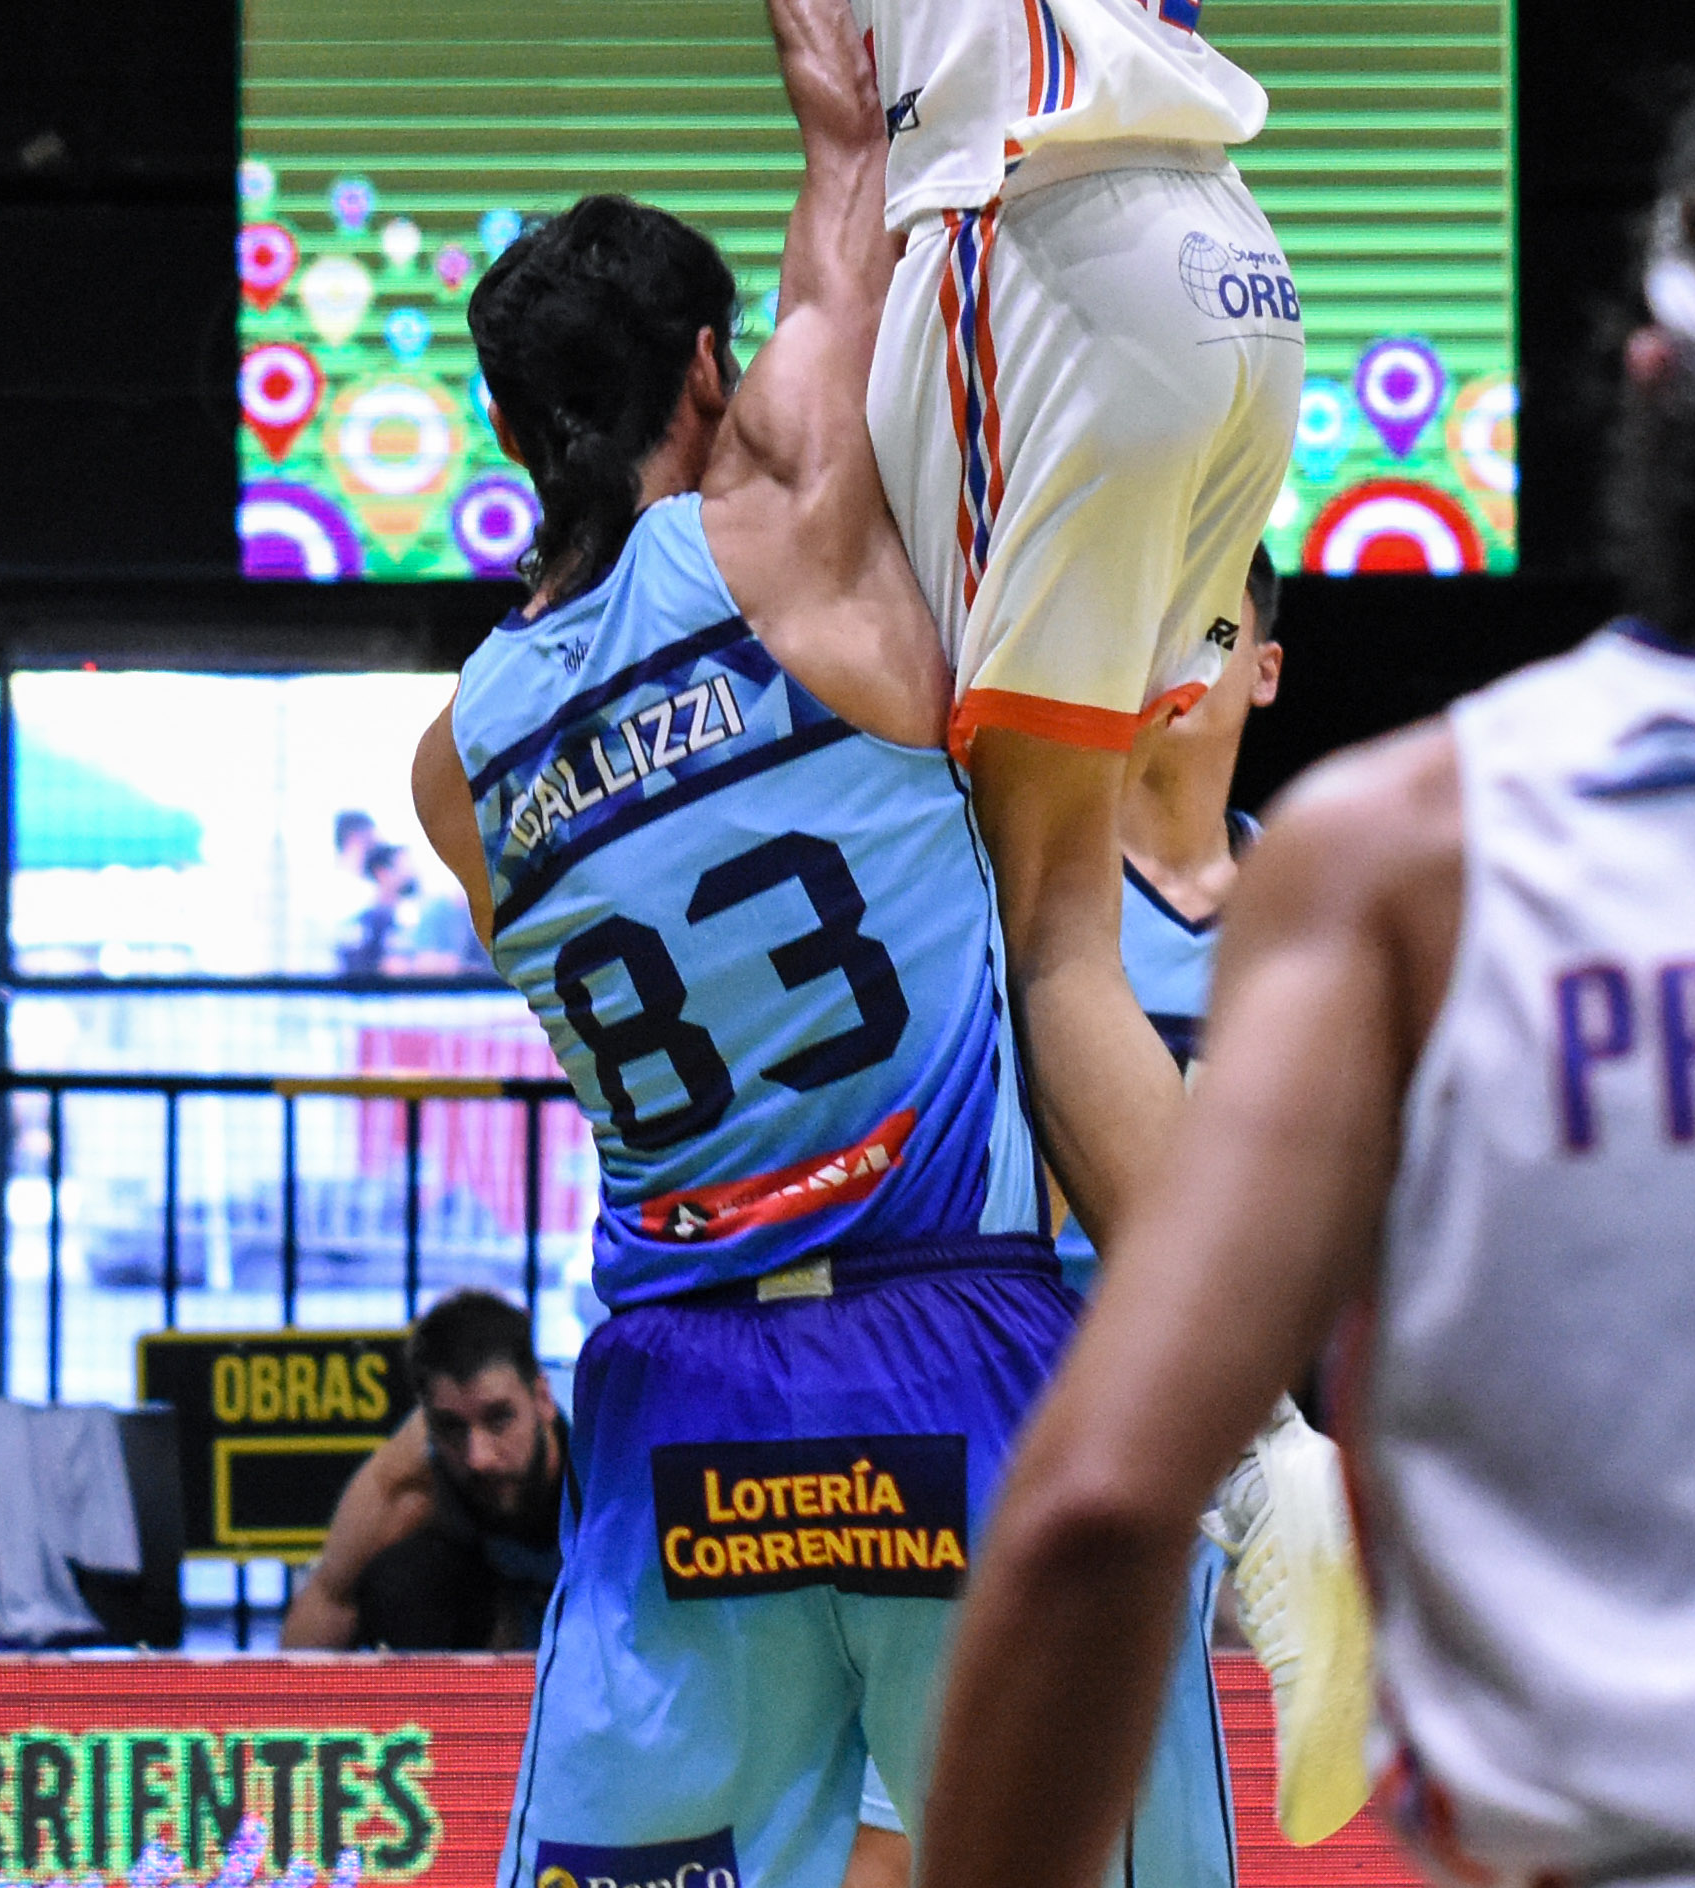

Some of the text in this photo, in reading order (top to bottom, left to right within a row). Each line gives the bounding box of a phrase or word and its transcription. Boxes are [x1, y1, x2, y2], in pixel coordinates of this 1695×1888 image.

[509, 674, 746, 852] GALLIZZI
[554, 830, 910, 1151] 83
[212, 1354, 390, 1422] OBRAS
[704, 1457, 906, 1524] LOTERÍA
[664, 1525, 969, 1579] CORRENTINA
